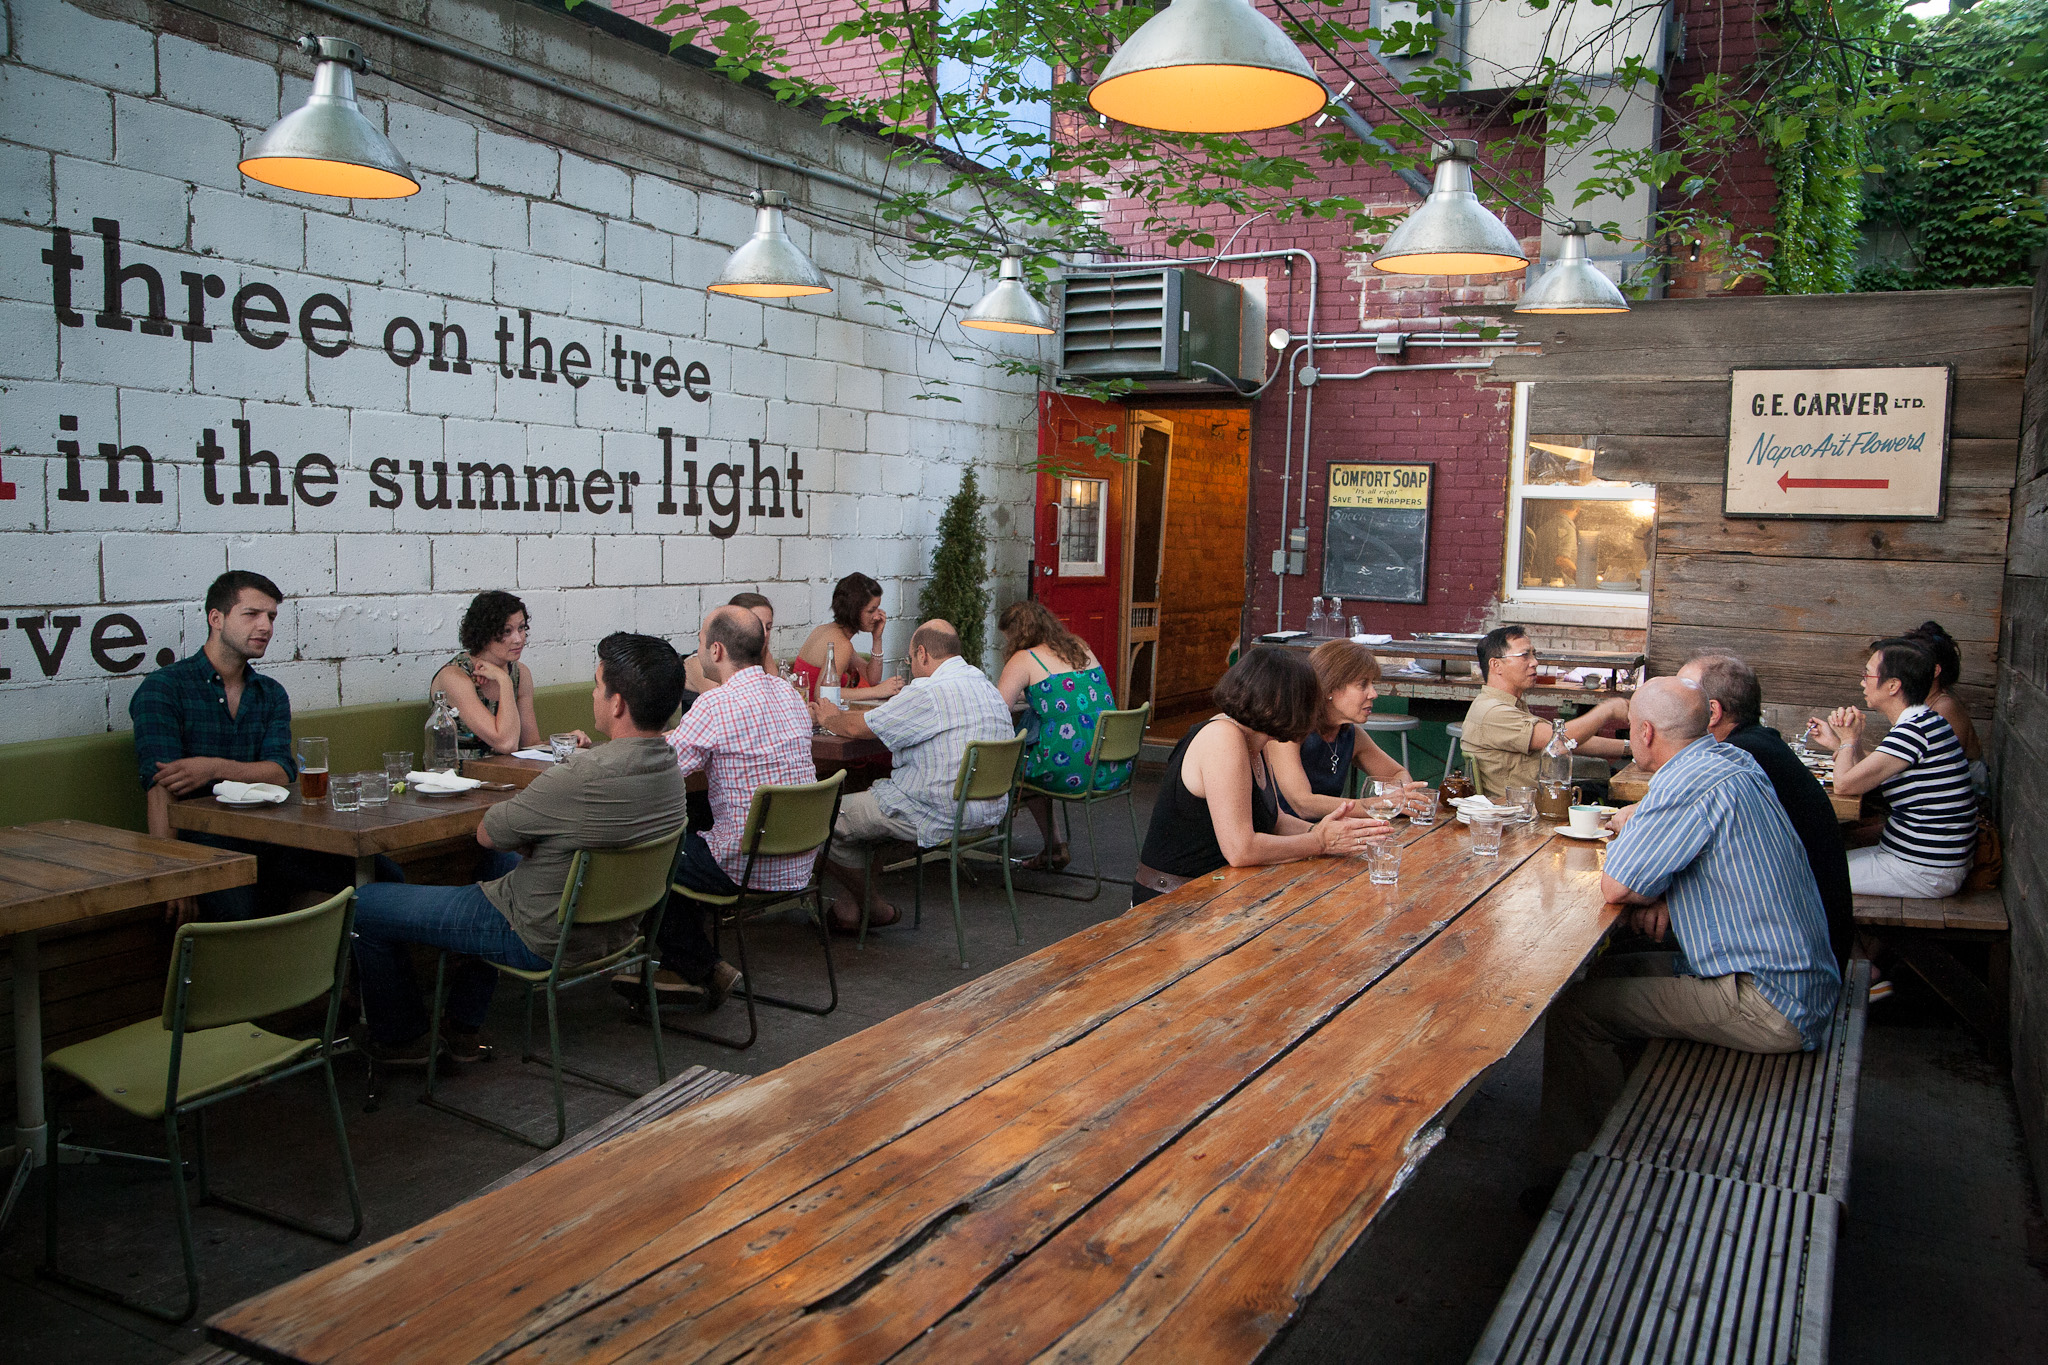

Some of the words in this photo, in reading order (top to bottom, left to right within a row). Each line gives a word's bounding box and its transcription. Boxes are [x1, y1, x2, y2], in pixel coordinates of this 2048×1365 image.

[41, 217, 353, 358] three
[383, 316, 472, 375] on
[495, 310, 591, 388] the
[611, 335, 711, 402] tree
[1793, 392, 1888, 416] CARVER
[1894, 398, 1925, 409] LTD.
[1747, 432, 1812, 468] Napco
[1810, 433, 1851, 458] Art
[1847, 431, 1926, 457] Flowers
[57, 414, 163, 502] in
[196, 419, 338, 506] the
[369, 457, 640, 514] summer
[657, 427, 803, 539] light
[1392, 469, 1427, 488] SOAP
